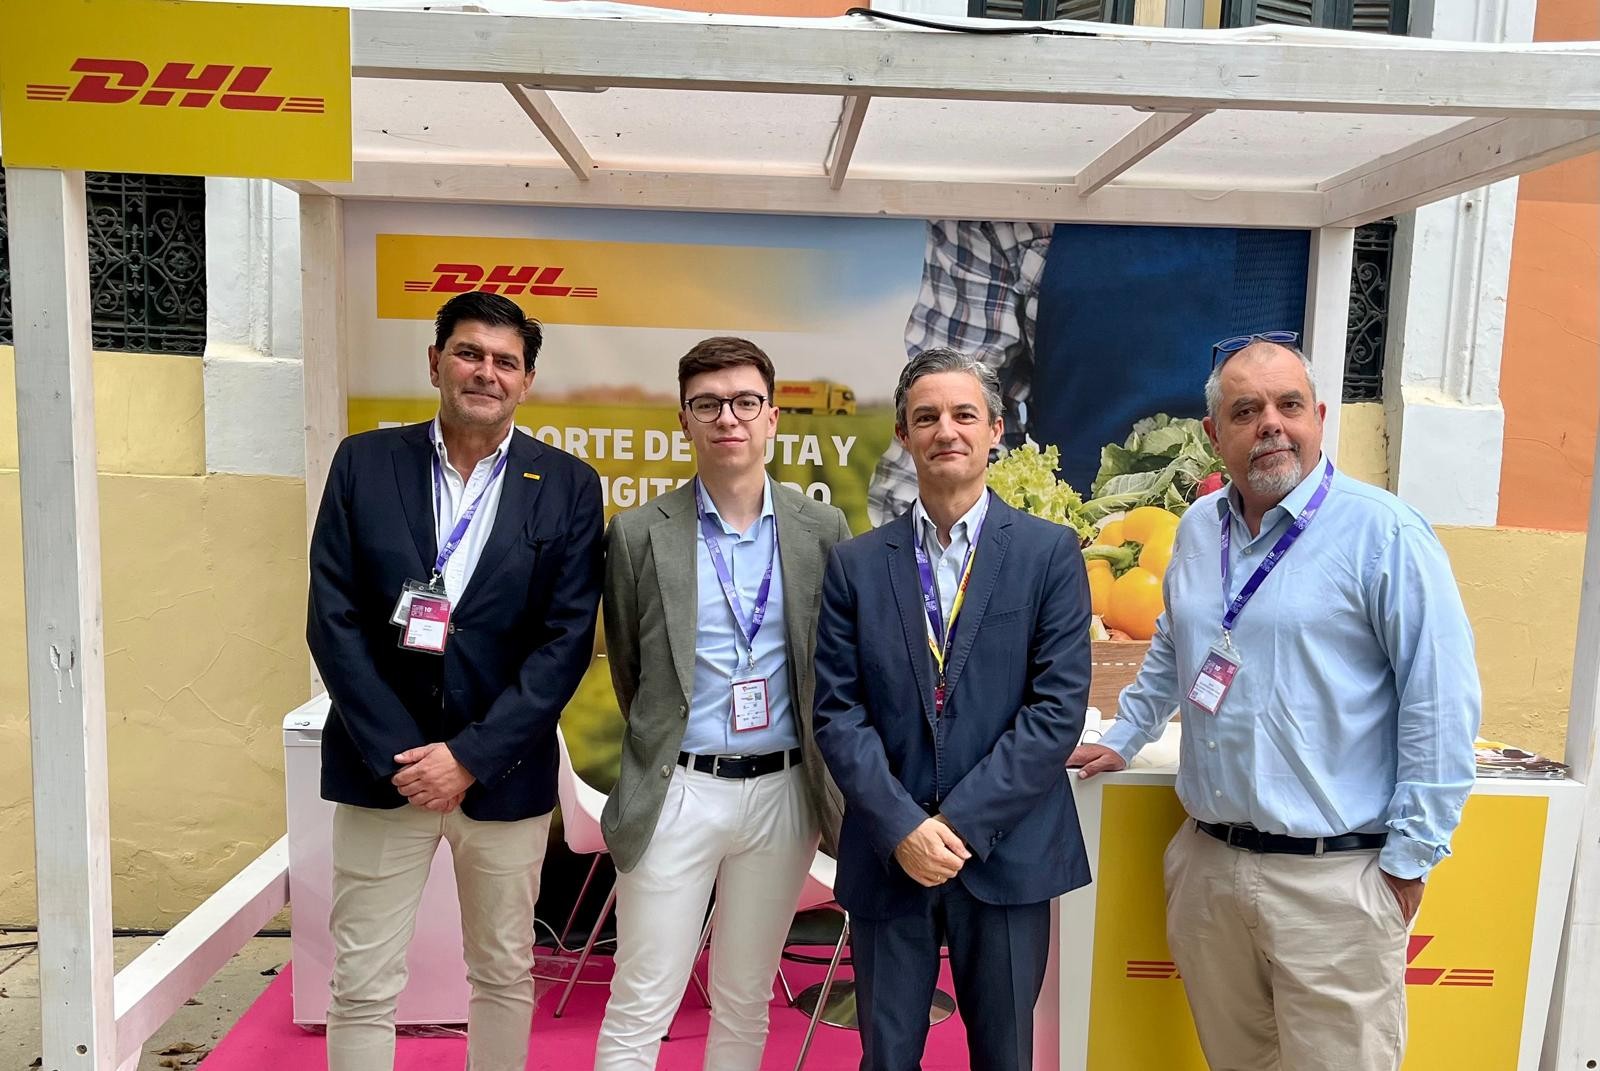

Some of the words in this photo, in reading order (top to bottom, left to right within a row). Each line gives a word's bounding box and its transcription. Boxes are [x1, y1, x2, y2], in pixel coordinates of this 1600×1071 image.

[67, 58, 286, 112] DHL
[430, 263, 573, 297] DHL
[644, 430, 692, 462] DE
[831, 436, 857, 467] Y
